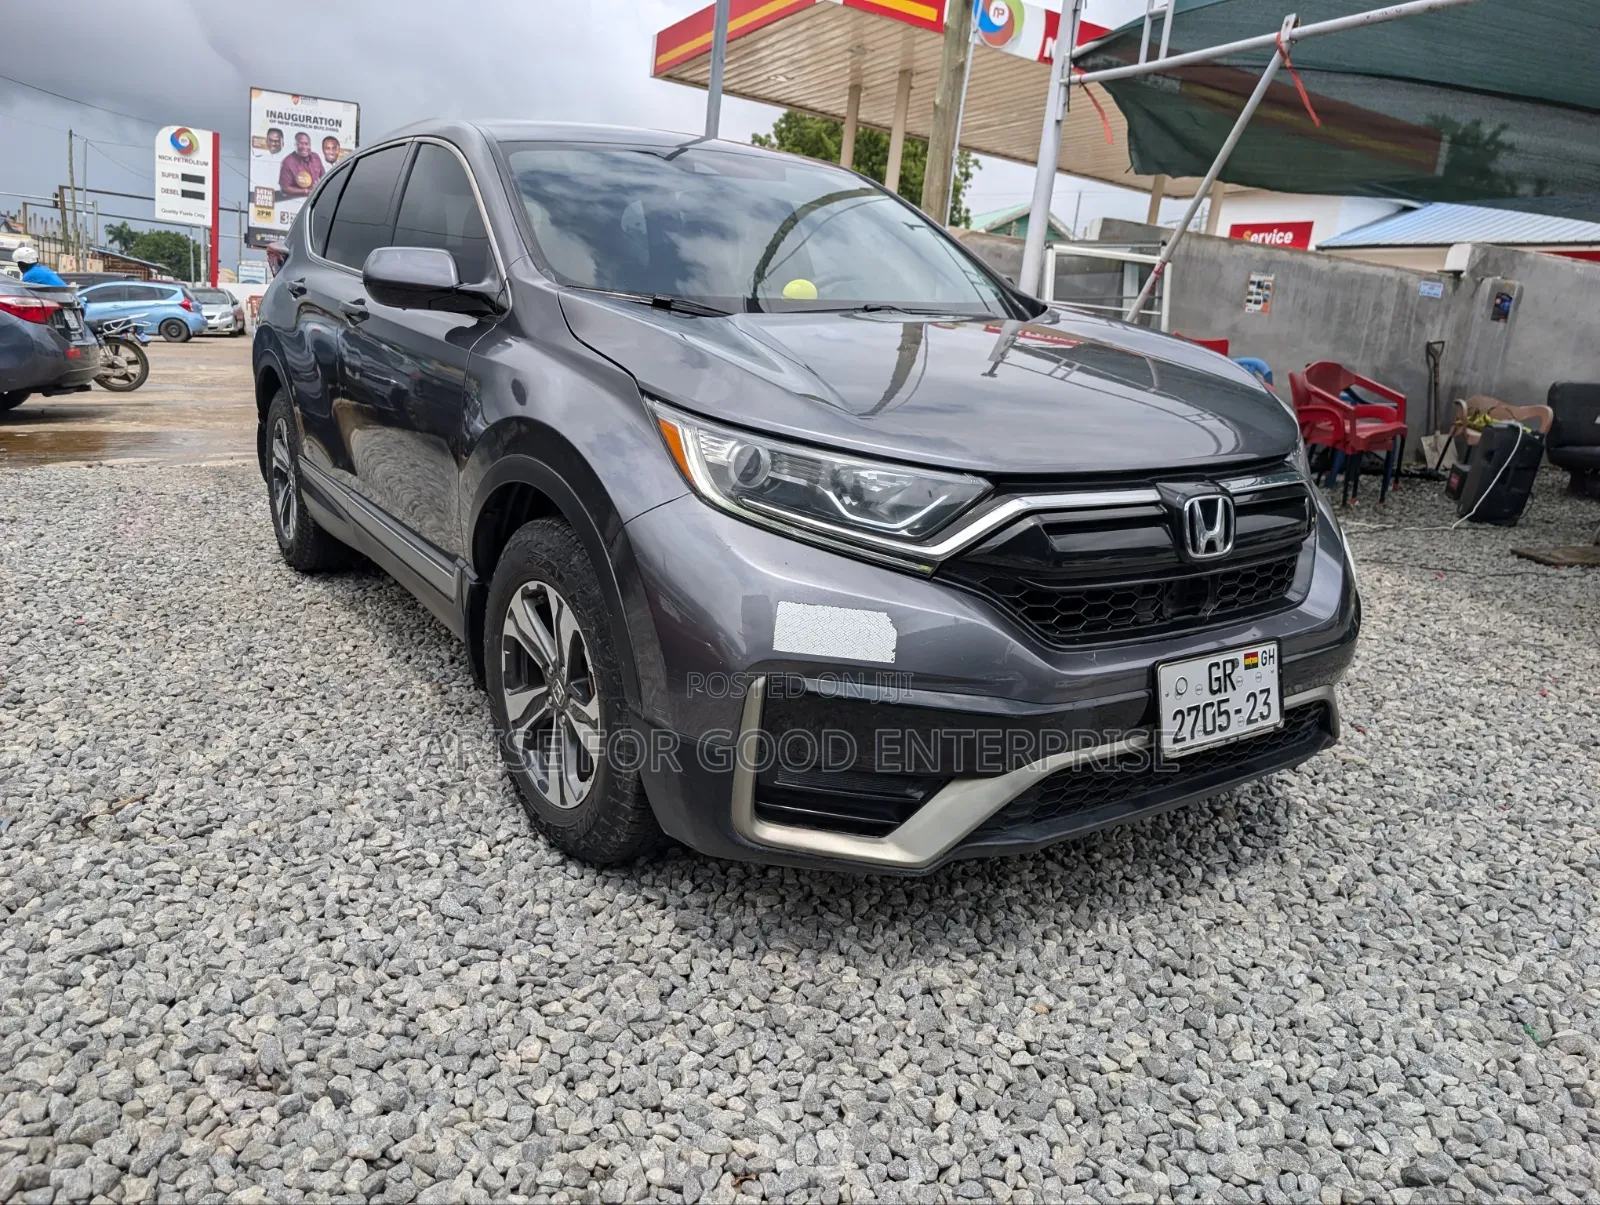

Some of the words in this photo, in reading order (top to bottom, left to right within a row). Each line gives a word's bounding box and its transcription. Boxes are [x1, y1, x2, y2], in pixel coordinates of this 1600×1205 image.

[266, 109, 342, 128] INAUGURATION
[313, 125, 339, 133] BUILDING
[157, 154, 173, 162] NICK
[173, 156, 209, 167] PETROLEUM
[161, 171, 180, 180] SUPER
[160, 187, 180, 196] DIESEL
[160, 207, 179, 216] Quality
[194, 211, 206, 220] Only
[256, 209, 272, 217] 2PM
[1243, 228, 1294, 244] Service
[1208, 658, 1238, 696] GR
[1261, 648, 1275, 667] GH
[1172, 687, 1271, 744] 2705-23
